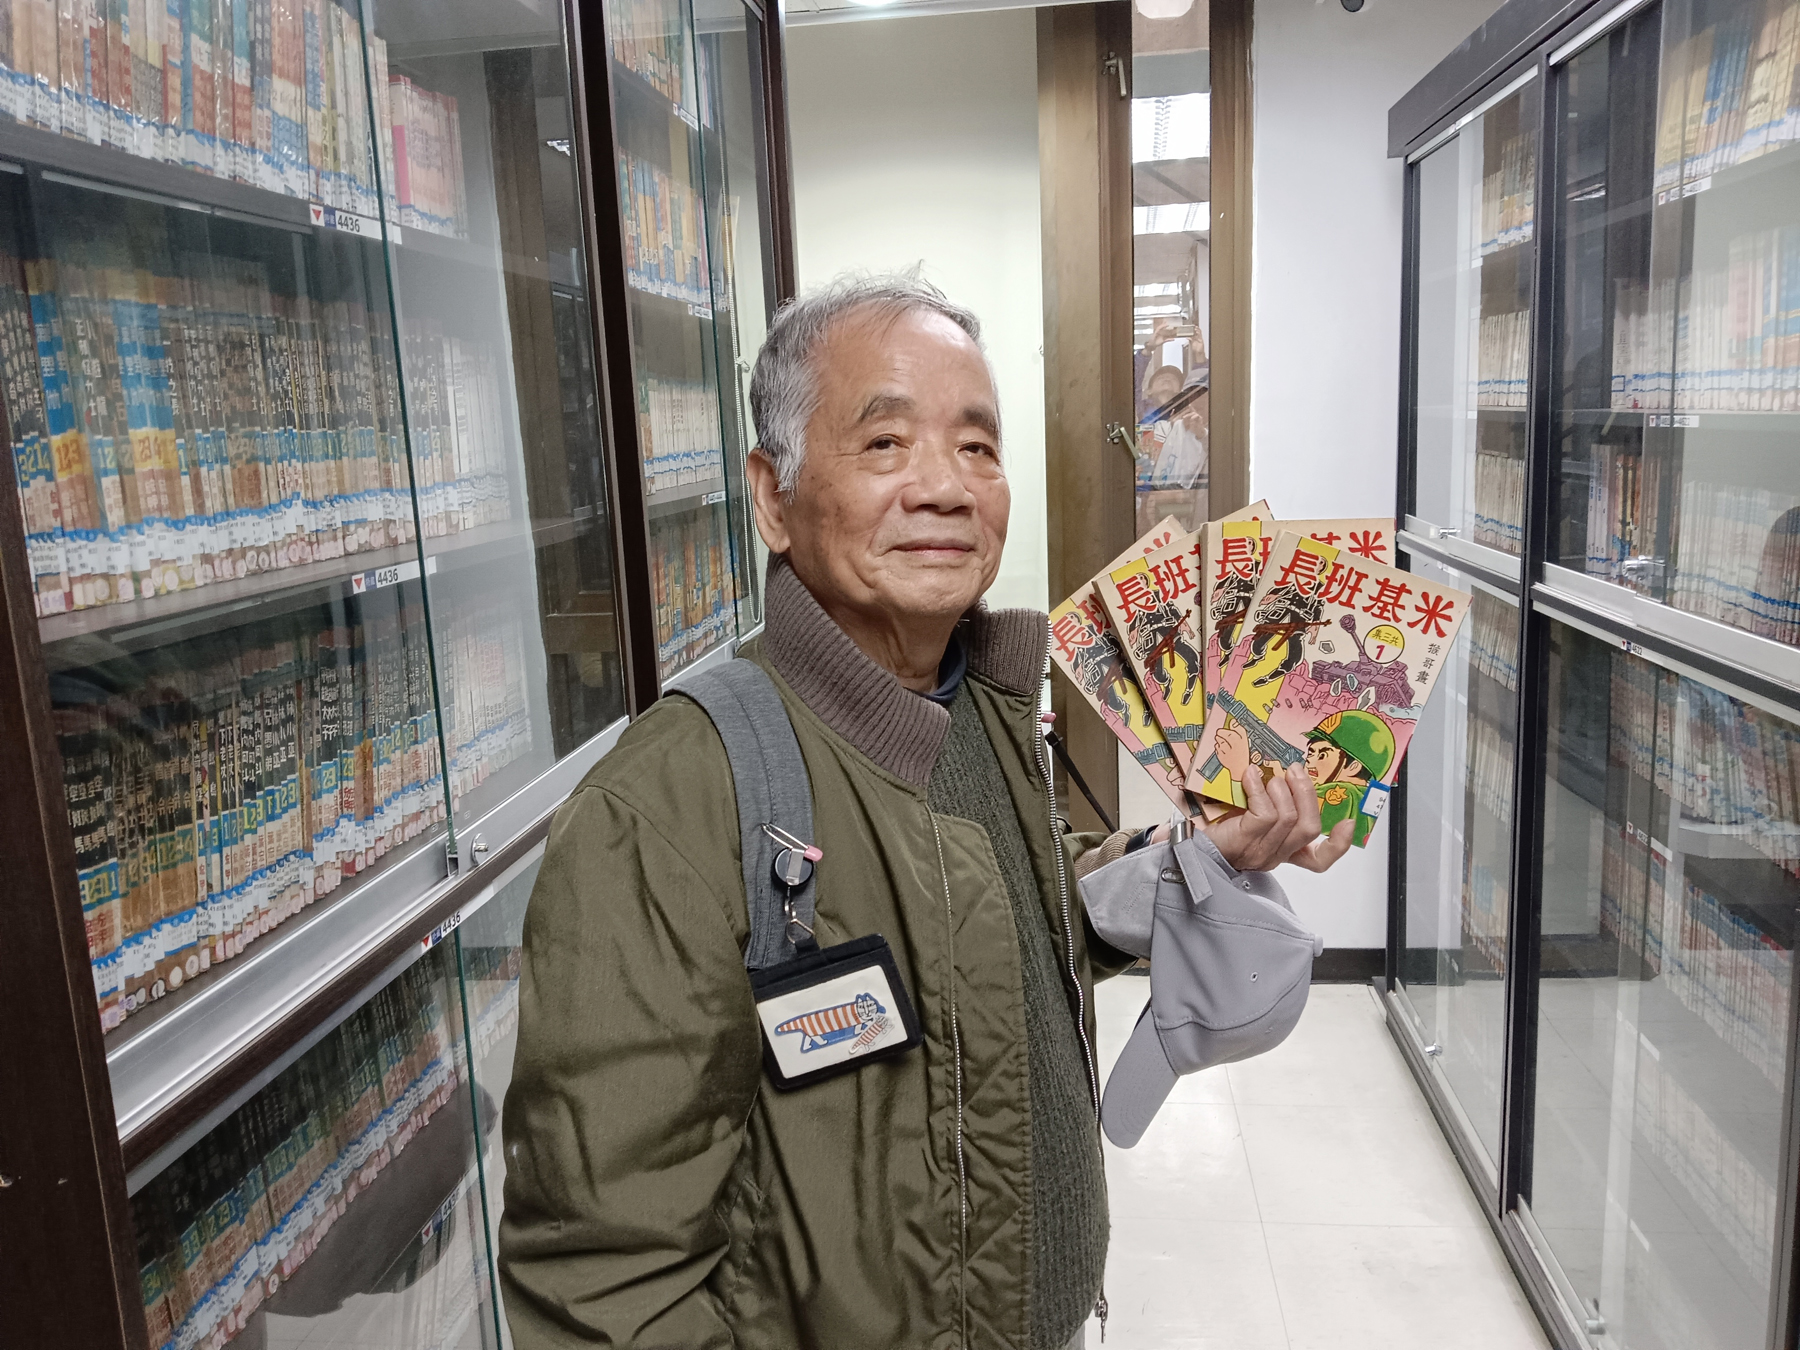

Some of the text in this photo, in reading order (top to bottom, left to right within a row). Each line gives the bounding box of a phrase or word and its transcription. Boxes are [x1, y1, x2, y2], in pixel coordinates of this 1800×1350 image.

[338, 215, 360, 233] 4436
[377, 568, 399, 585] 4436
[1375, 644, 1386, 661] 1
[442, 911, 461, 933] 4436
